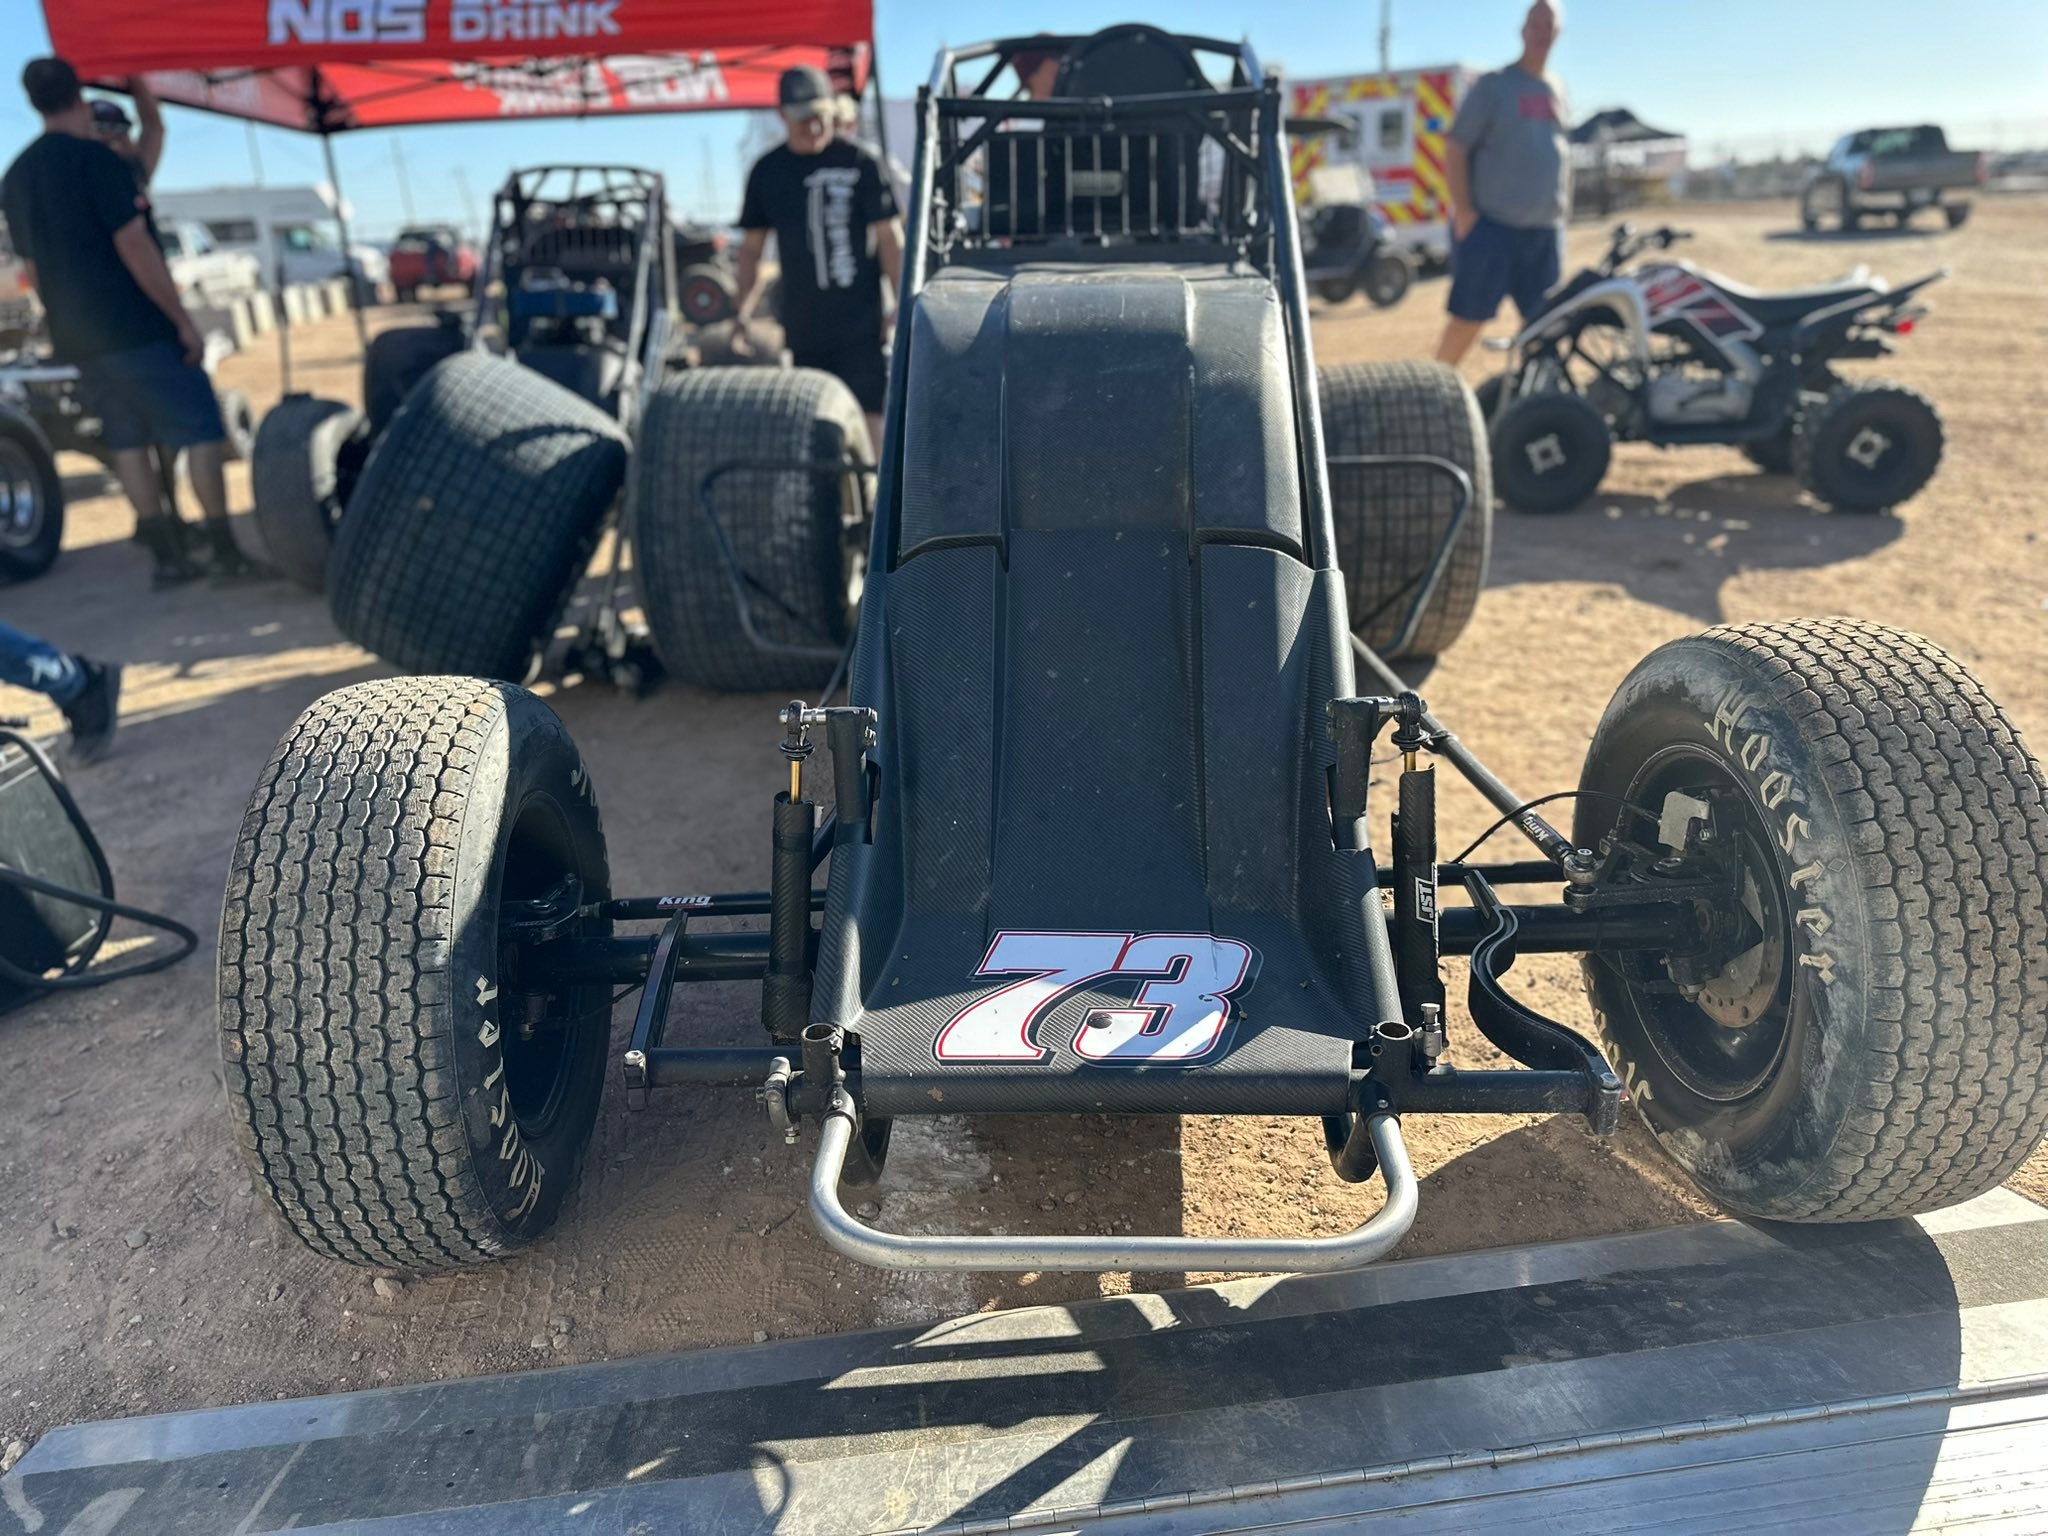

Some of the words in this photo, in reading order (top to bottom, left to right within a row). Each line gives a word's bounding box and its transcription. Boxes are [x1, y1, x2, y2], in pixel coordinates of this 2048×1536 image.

[267, 0, 426, 44] NOS
[452, 2, 622, 42] DRINK
[1521, 814, 1549, 842] King
[657, 895, 713, 907] King
[1418, 883, 1435, 919] JST
[936, 930, 1254, 1061] 73
